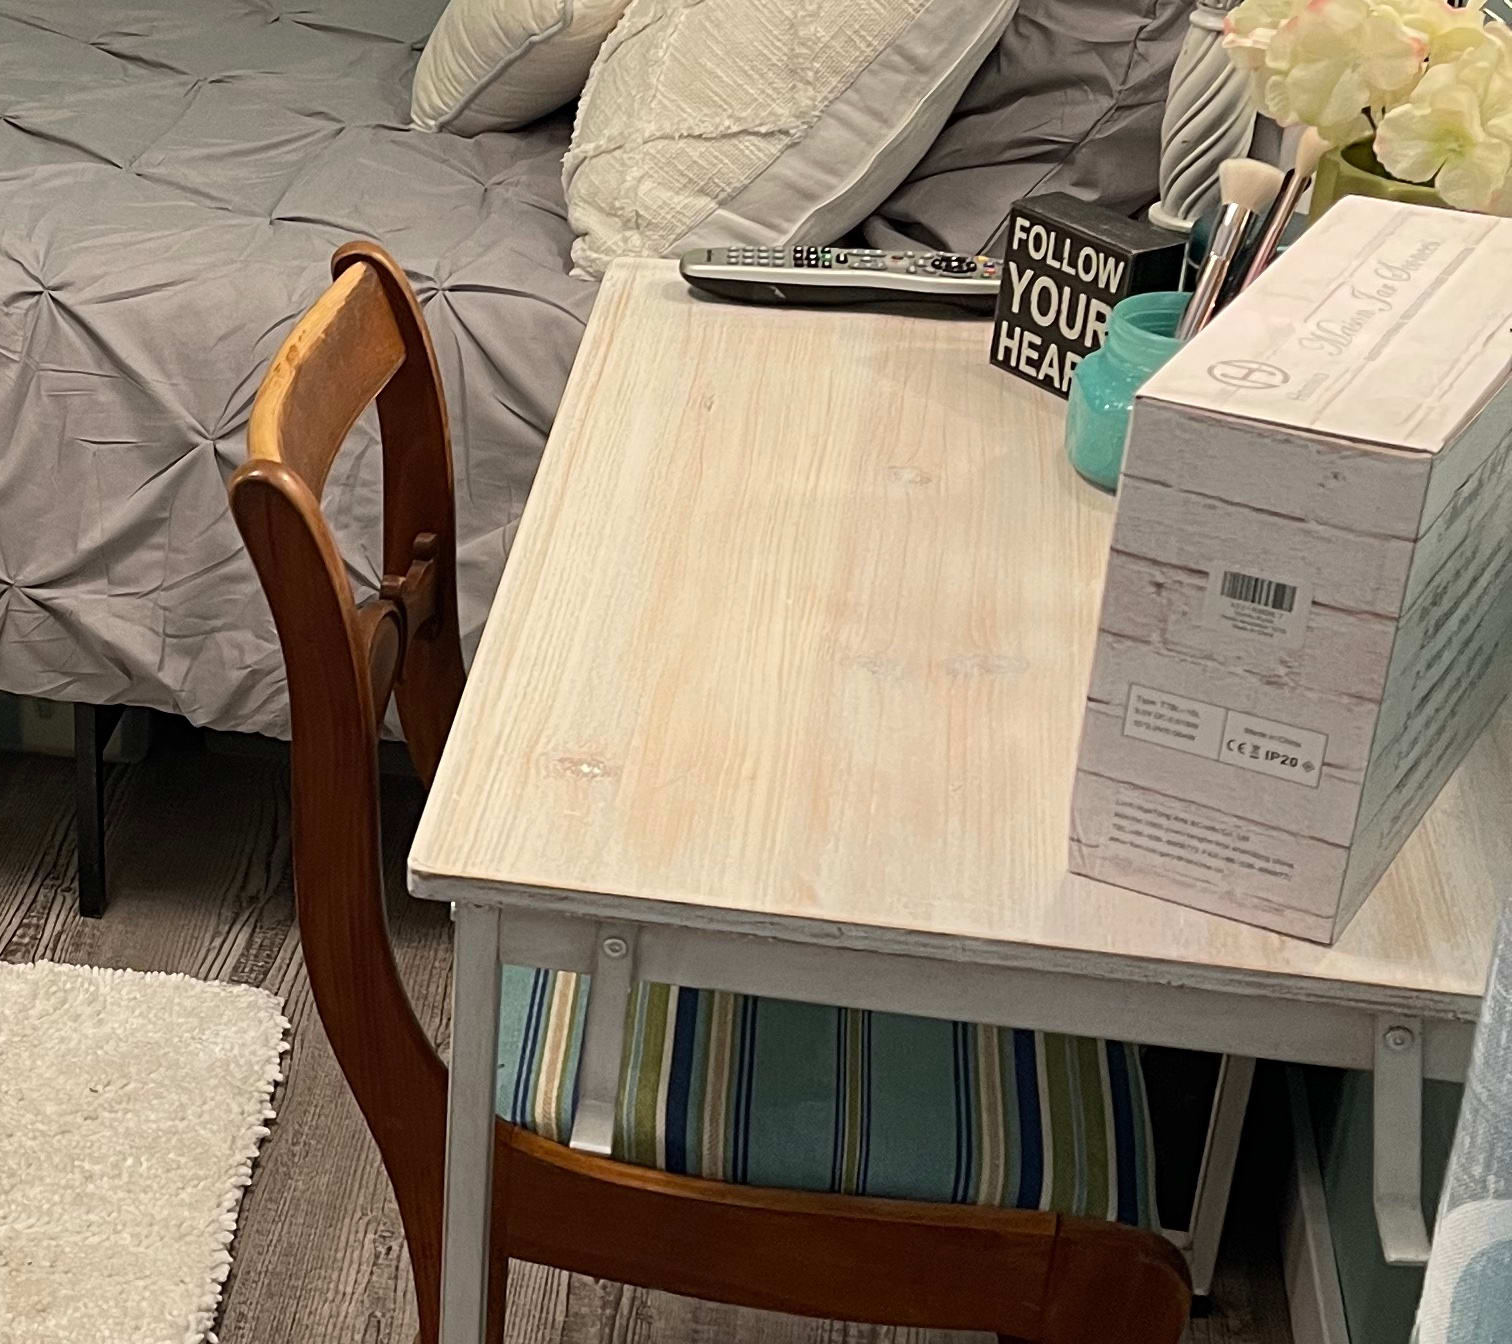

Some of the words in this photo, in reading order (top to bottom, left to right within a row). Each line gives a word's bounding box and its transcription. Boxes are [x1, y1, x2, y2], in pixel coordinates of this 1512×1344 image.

[1012, 216, 1125, 294] FOLLOW
[1008, 261, 1113, 348] YOUR
[1264, 750, 1298, 768] IP20
